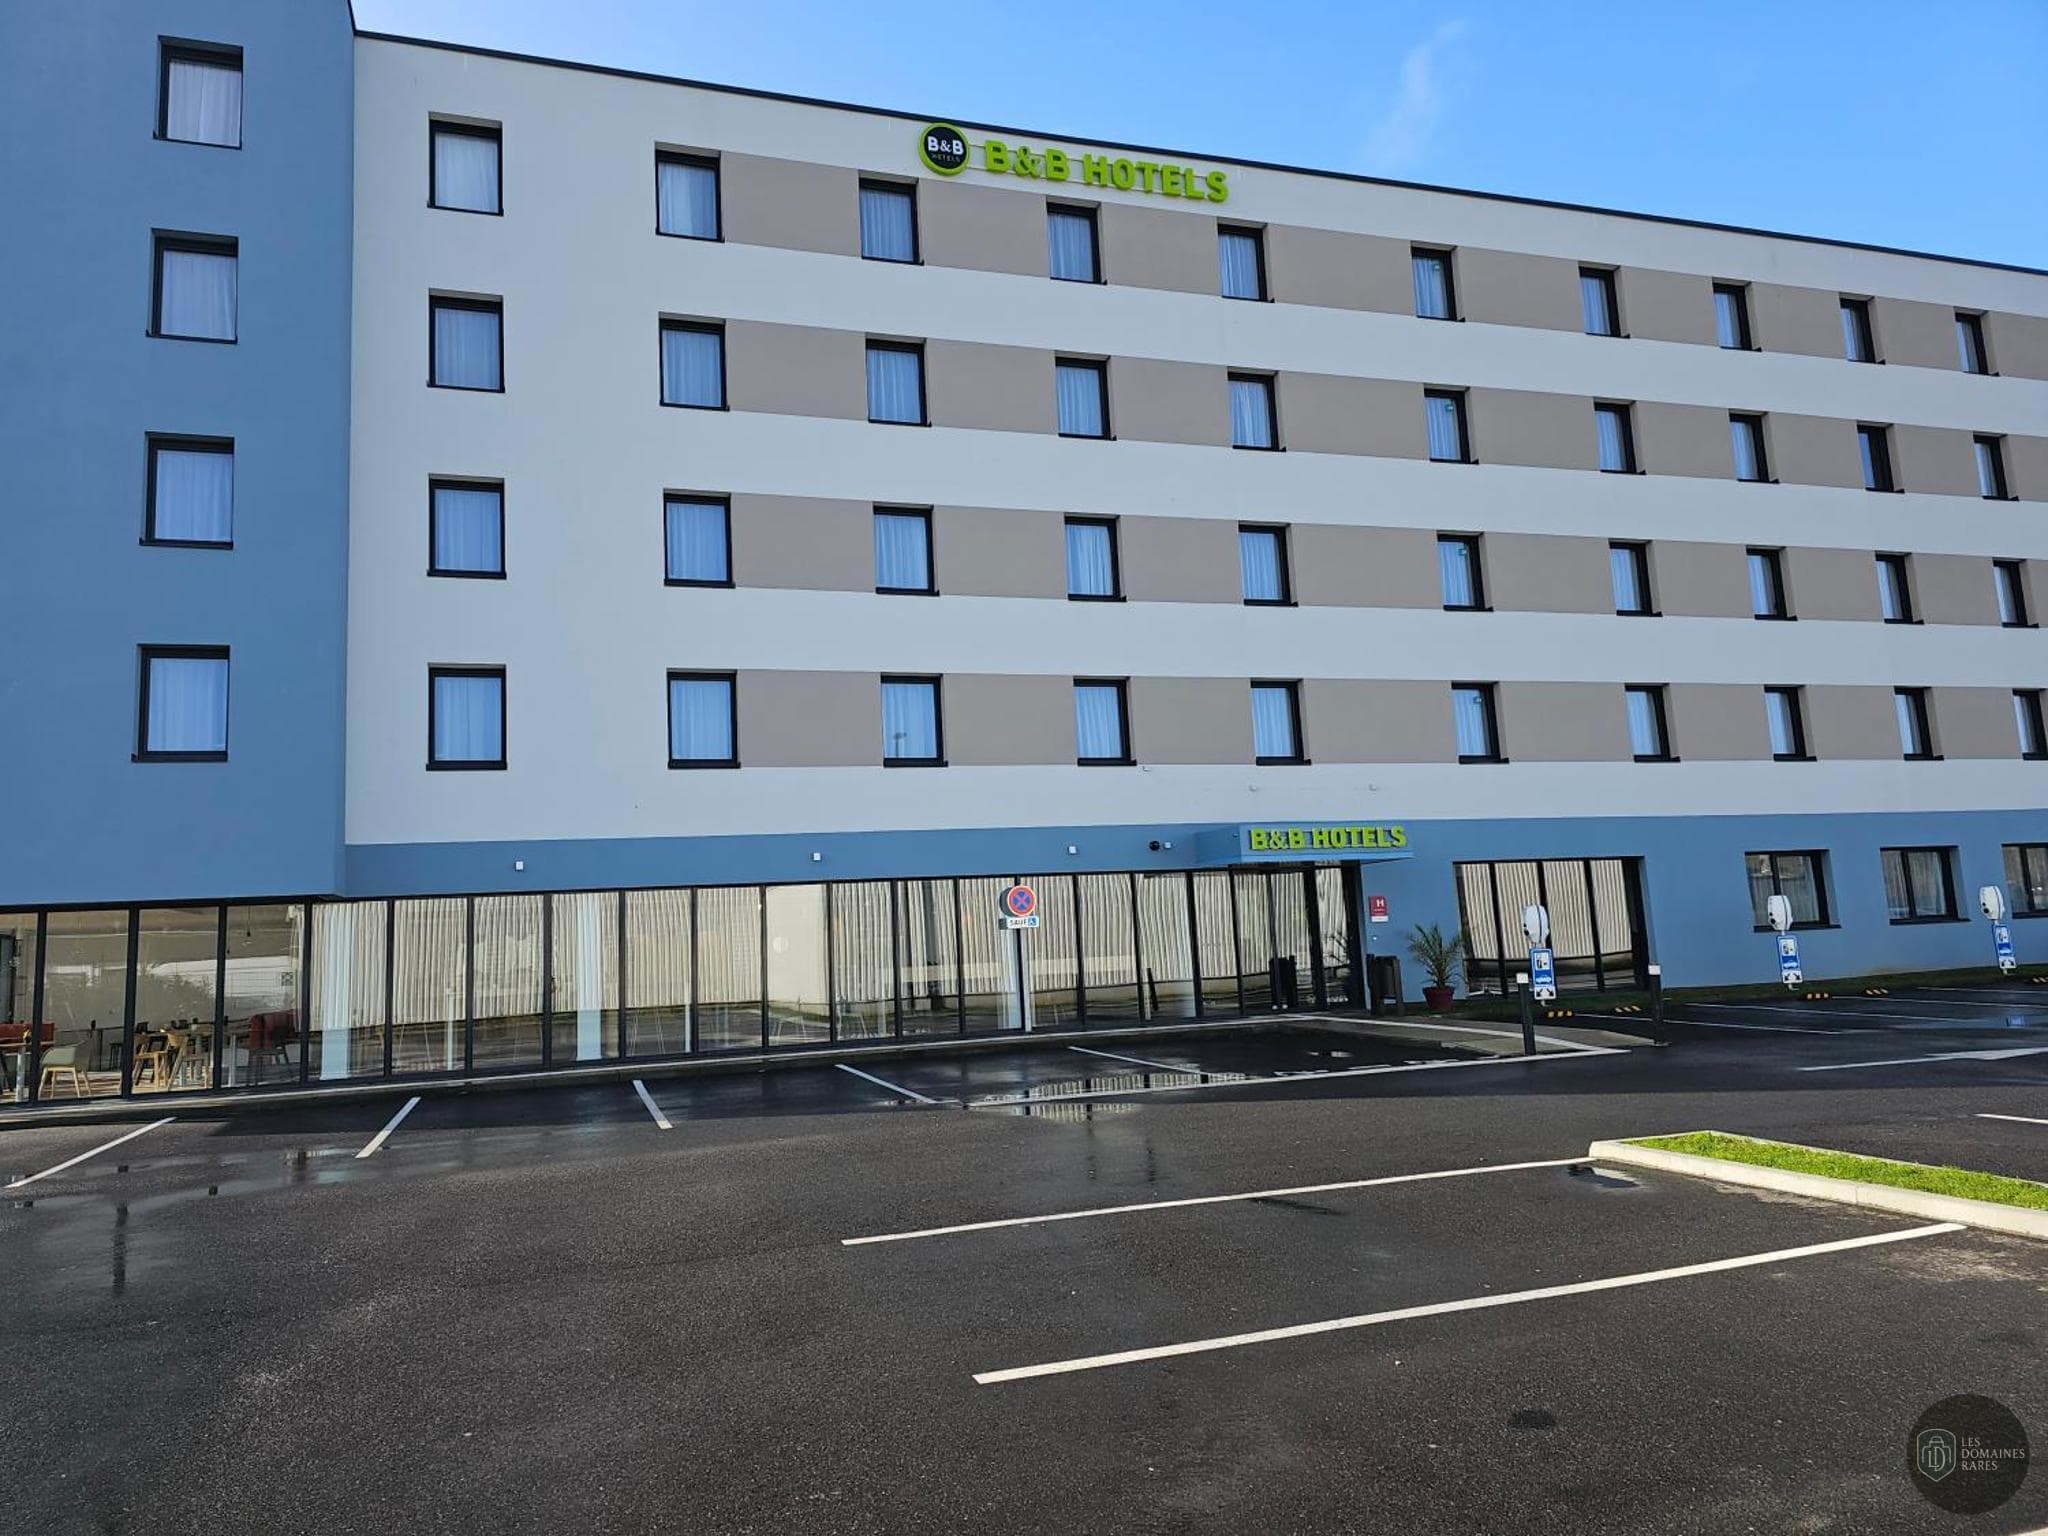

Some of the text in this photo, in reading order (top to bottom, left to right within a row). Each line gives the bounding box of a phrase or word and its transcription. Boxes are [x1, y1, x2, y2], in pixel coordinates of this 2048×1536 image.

[928, 136, 964, 155] B&B
[984, 140, 1230, 203] B&B HOTELS
[1251, 825, 1407, 850] B&B HOTELS
